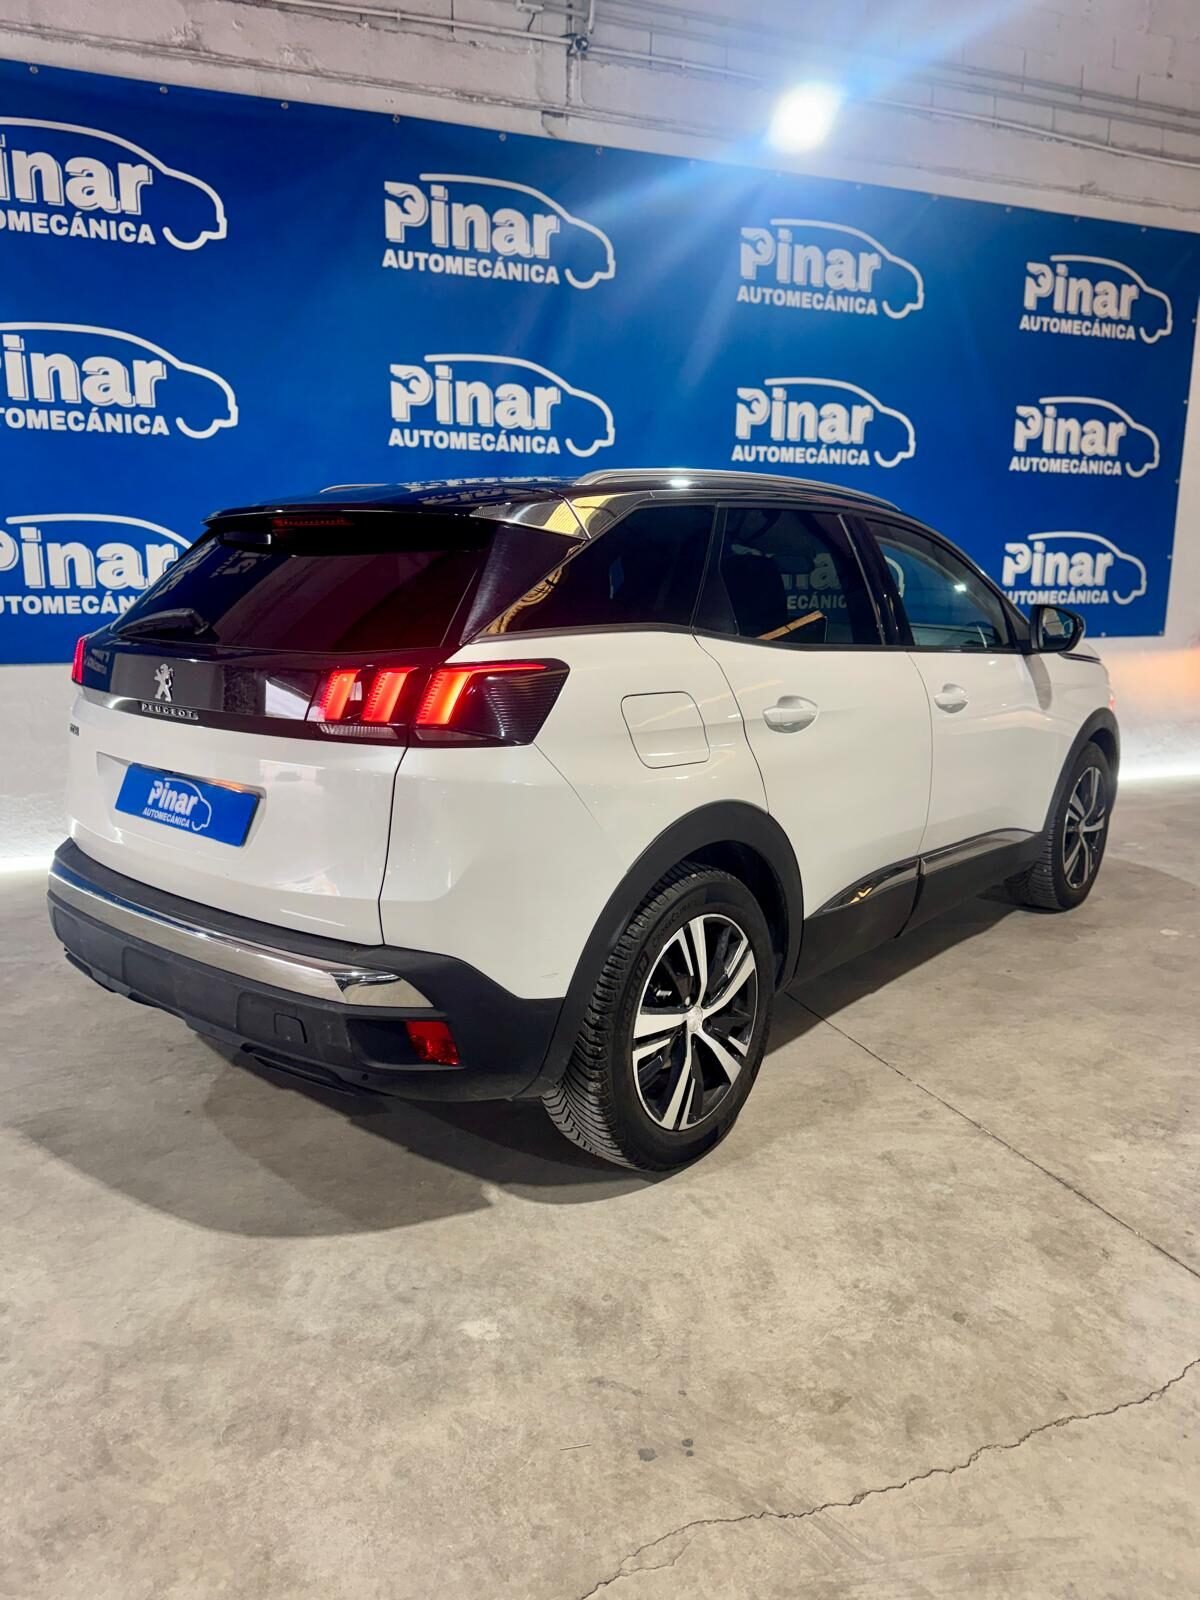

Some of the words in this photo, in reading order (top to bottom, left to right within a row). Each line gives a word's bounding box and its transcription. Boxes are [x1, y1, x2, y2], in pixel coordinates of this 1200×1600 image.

[384, 181, 560, 259] Pinar
[382, 248, 560, 285] AUTOMECÁNICA
[740, 227, 881, 292] Pinar
[736, 285, 878, 315] AUTOMECÁNICA
[1024, 262, 1139, 320] Pinar
[1019, 315, 1136, 341] AUTOMECÁNICA
[0, 334, 167, 408] inar
[389, 364, 561, 430] Pinar
[0, 407, 170, 436] OMECÁNICA
[735, 387, 874, 444] Pinar
[1013, 405, 1127, 457] Pinar
[388, 428, 560, 455] AUTOMECÁNICA
[731, 444, 870, 466] AUTOMECÁNICA
[1009, 455, 1122, 476] AUTOMECÁNICA
[1002, 541, 1114, 587] Pinar
[1003, 587, 1109, 605] UTOMECÁNICA
[141, 703, 199, 720] PEUGEOT
[147, 780, 199, 816] Pinar
[142, 807, 190, 828] AUTOMECÁNICA
